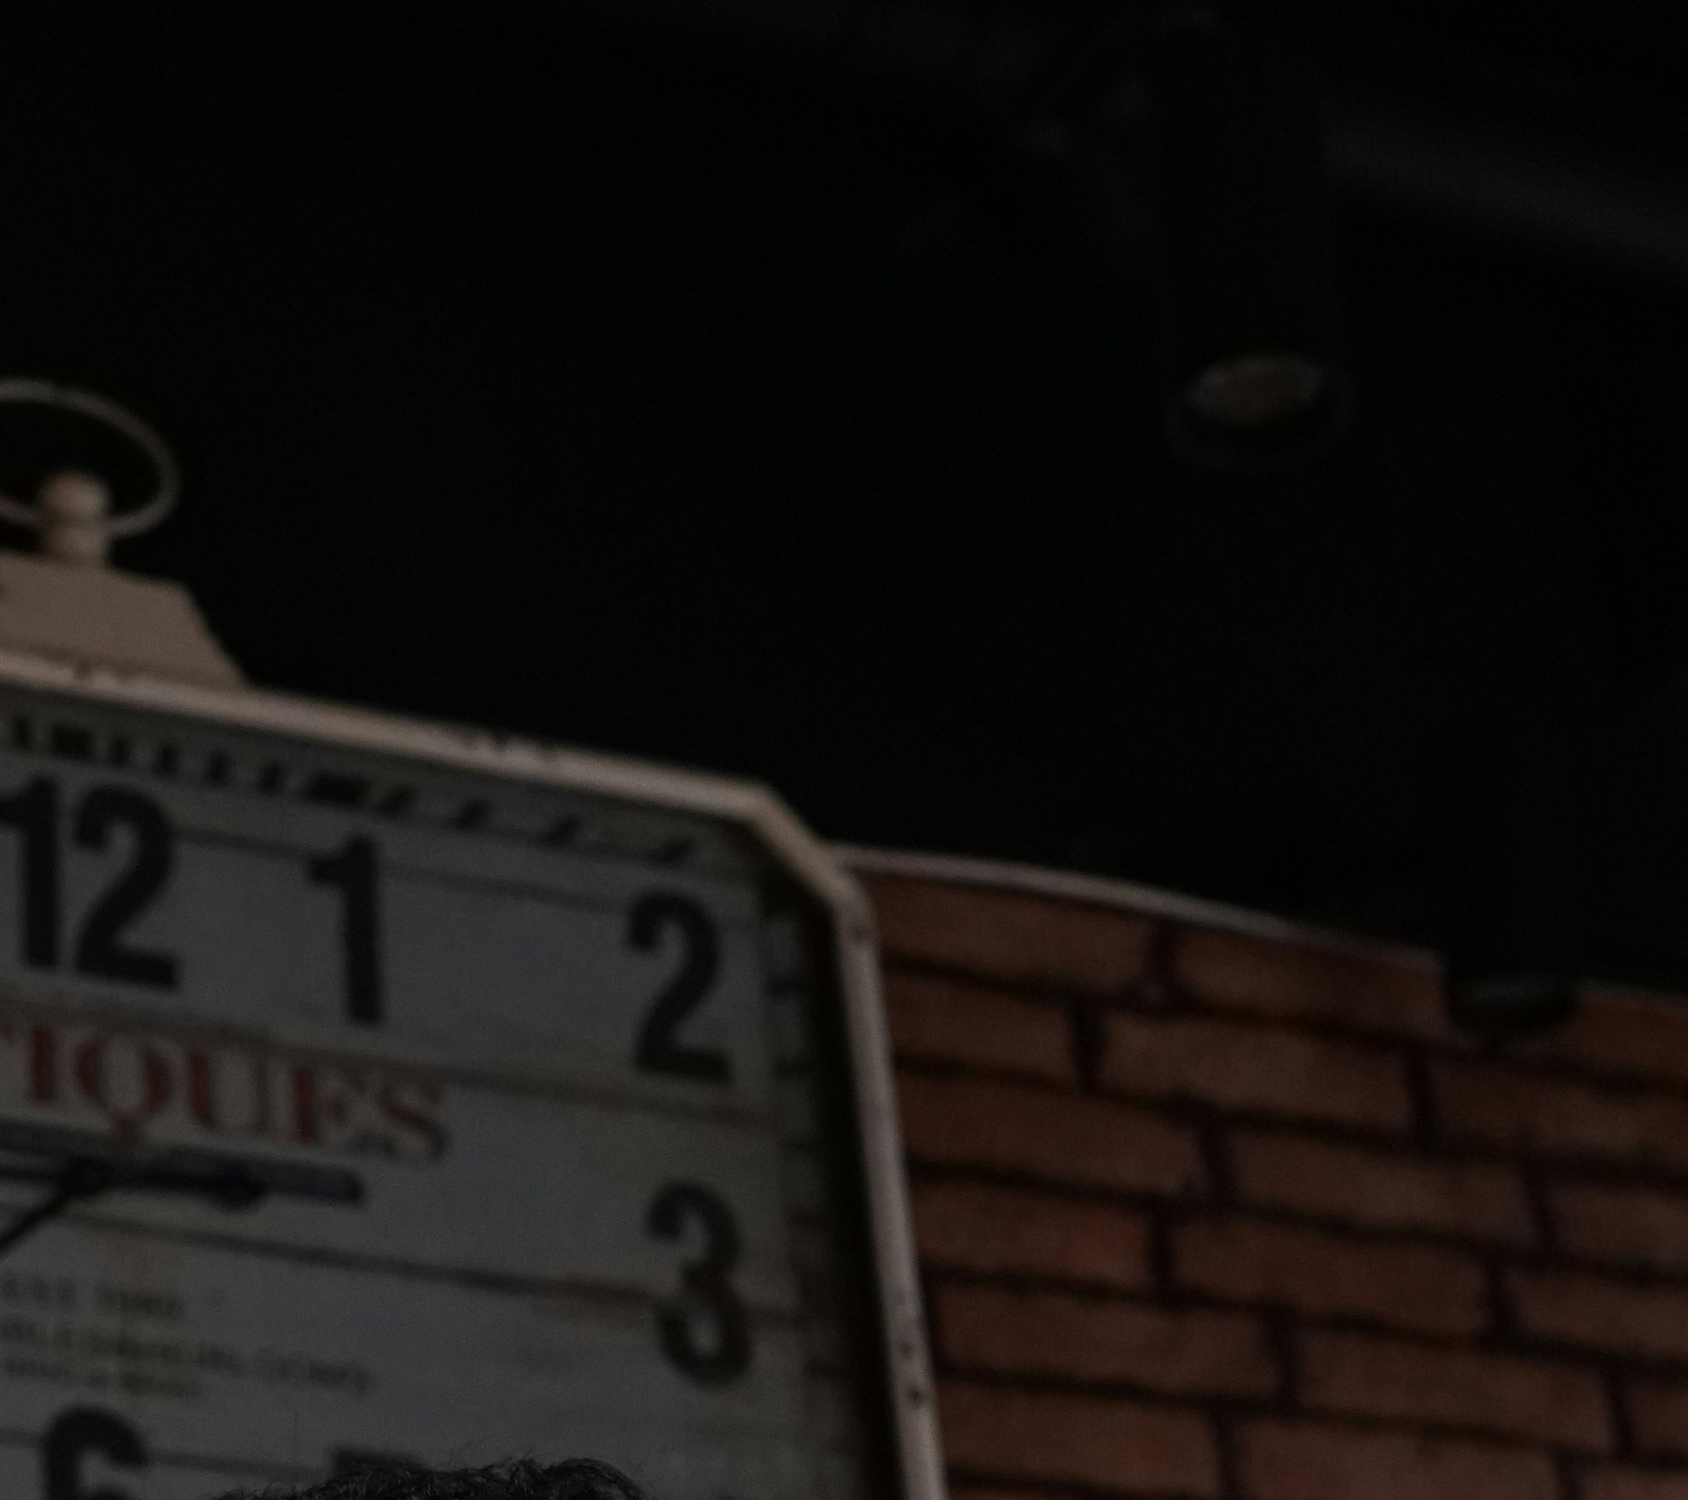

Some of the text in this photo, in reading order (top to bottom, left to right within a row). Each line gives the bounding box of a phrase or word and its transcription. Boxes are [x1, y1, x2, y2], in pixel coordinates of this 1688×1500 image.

[308, 832, 384, 1026] 1
[626, 890, 730, 1084] 2
[646, 1182, 752, 1388] 3
